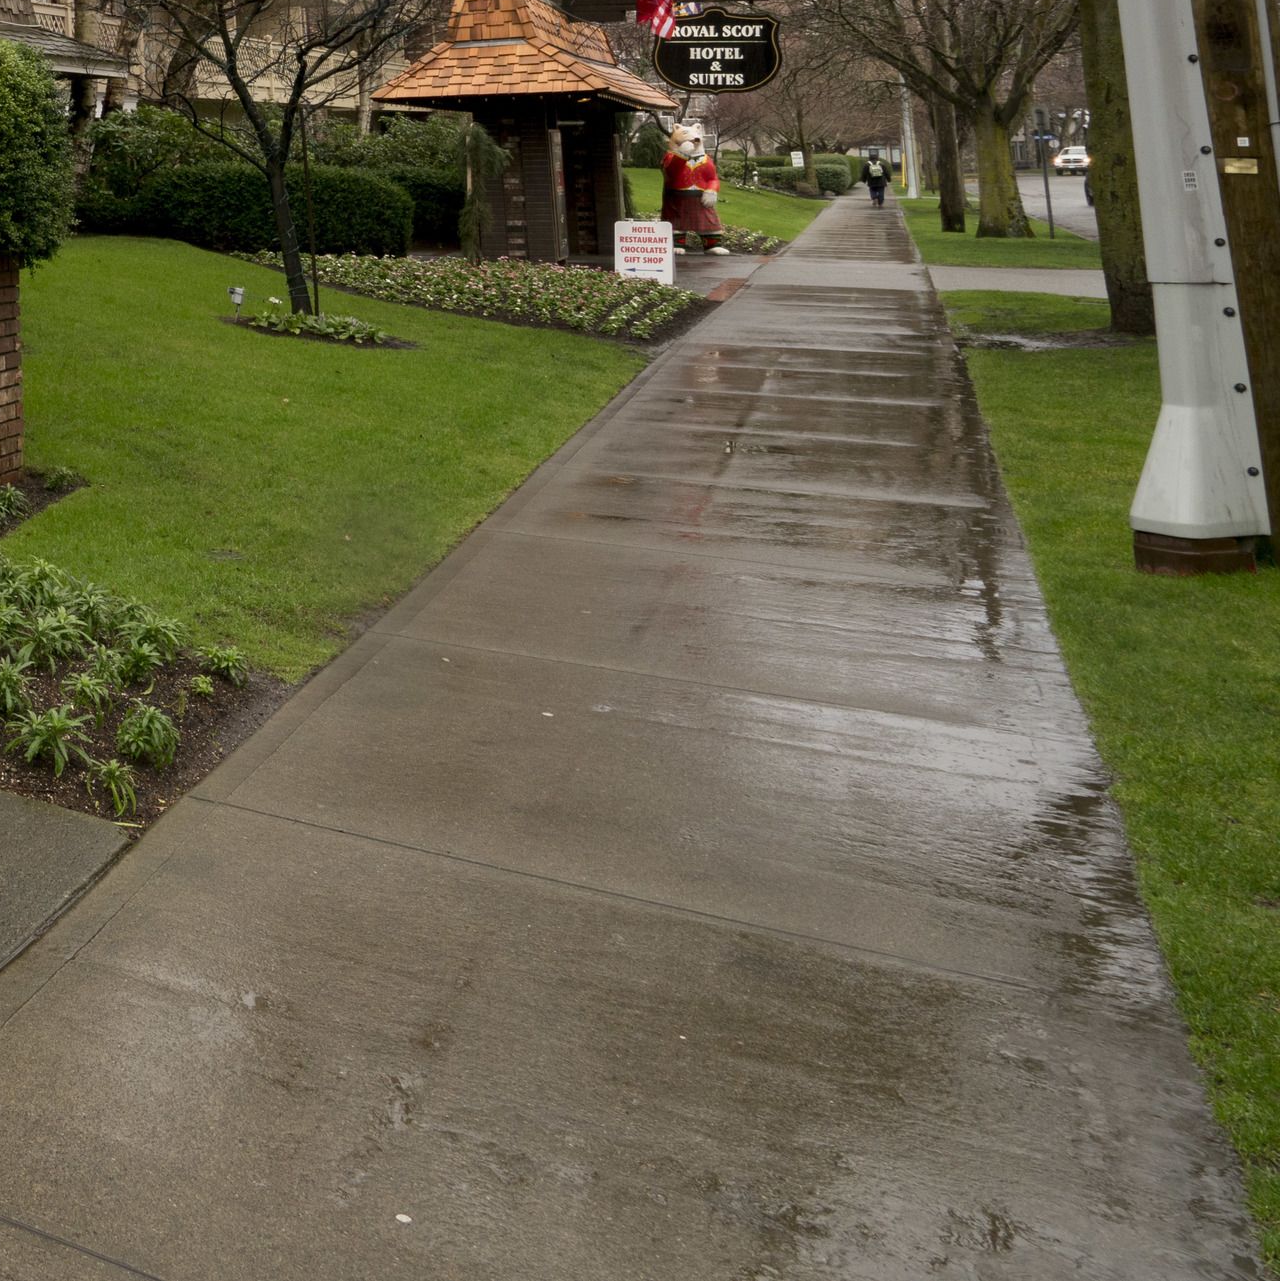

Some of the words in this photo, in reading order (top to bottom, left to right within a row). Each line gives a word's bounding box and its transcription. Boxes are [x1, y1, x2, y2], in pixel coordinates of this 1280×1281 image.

[671, 24, 718, 38] ROYAL
[722, 24, 764, 38] SCOT
[689, 47, 744, 60] HOTEL
[709, 61, 722, 71] &
[689, 73, 744, 86] SUITES
[631, 226, 656, 234] HOTEL
[619, 236, 668, 244] RESTAURANT
[620, 246, 668, 254] CHOCOLATES
[642, 256, 664, 264] SHOP
